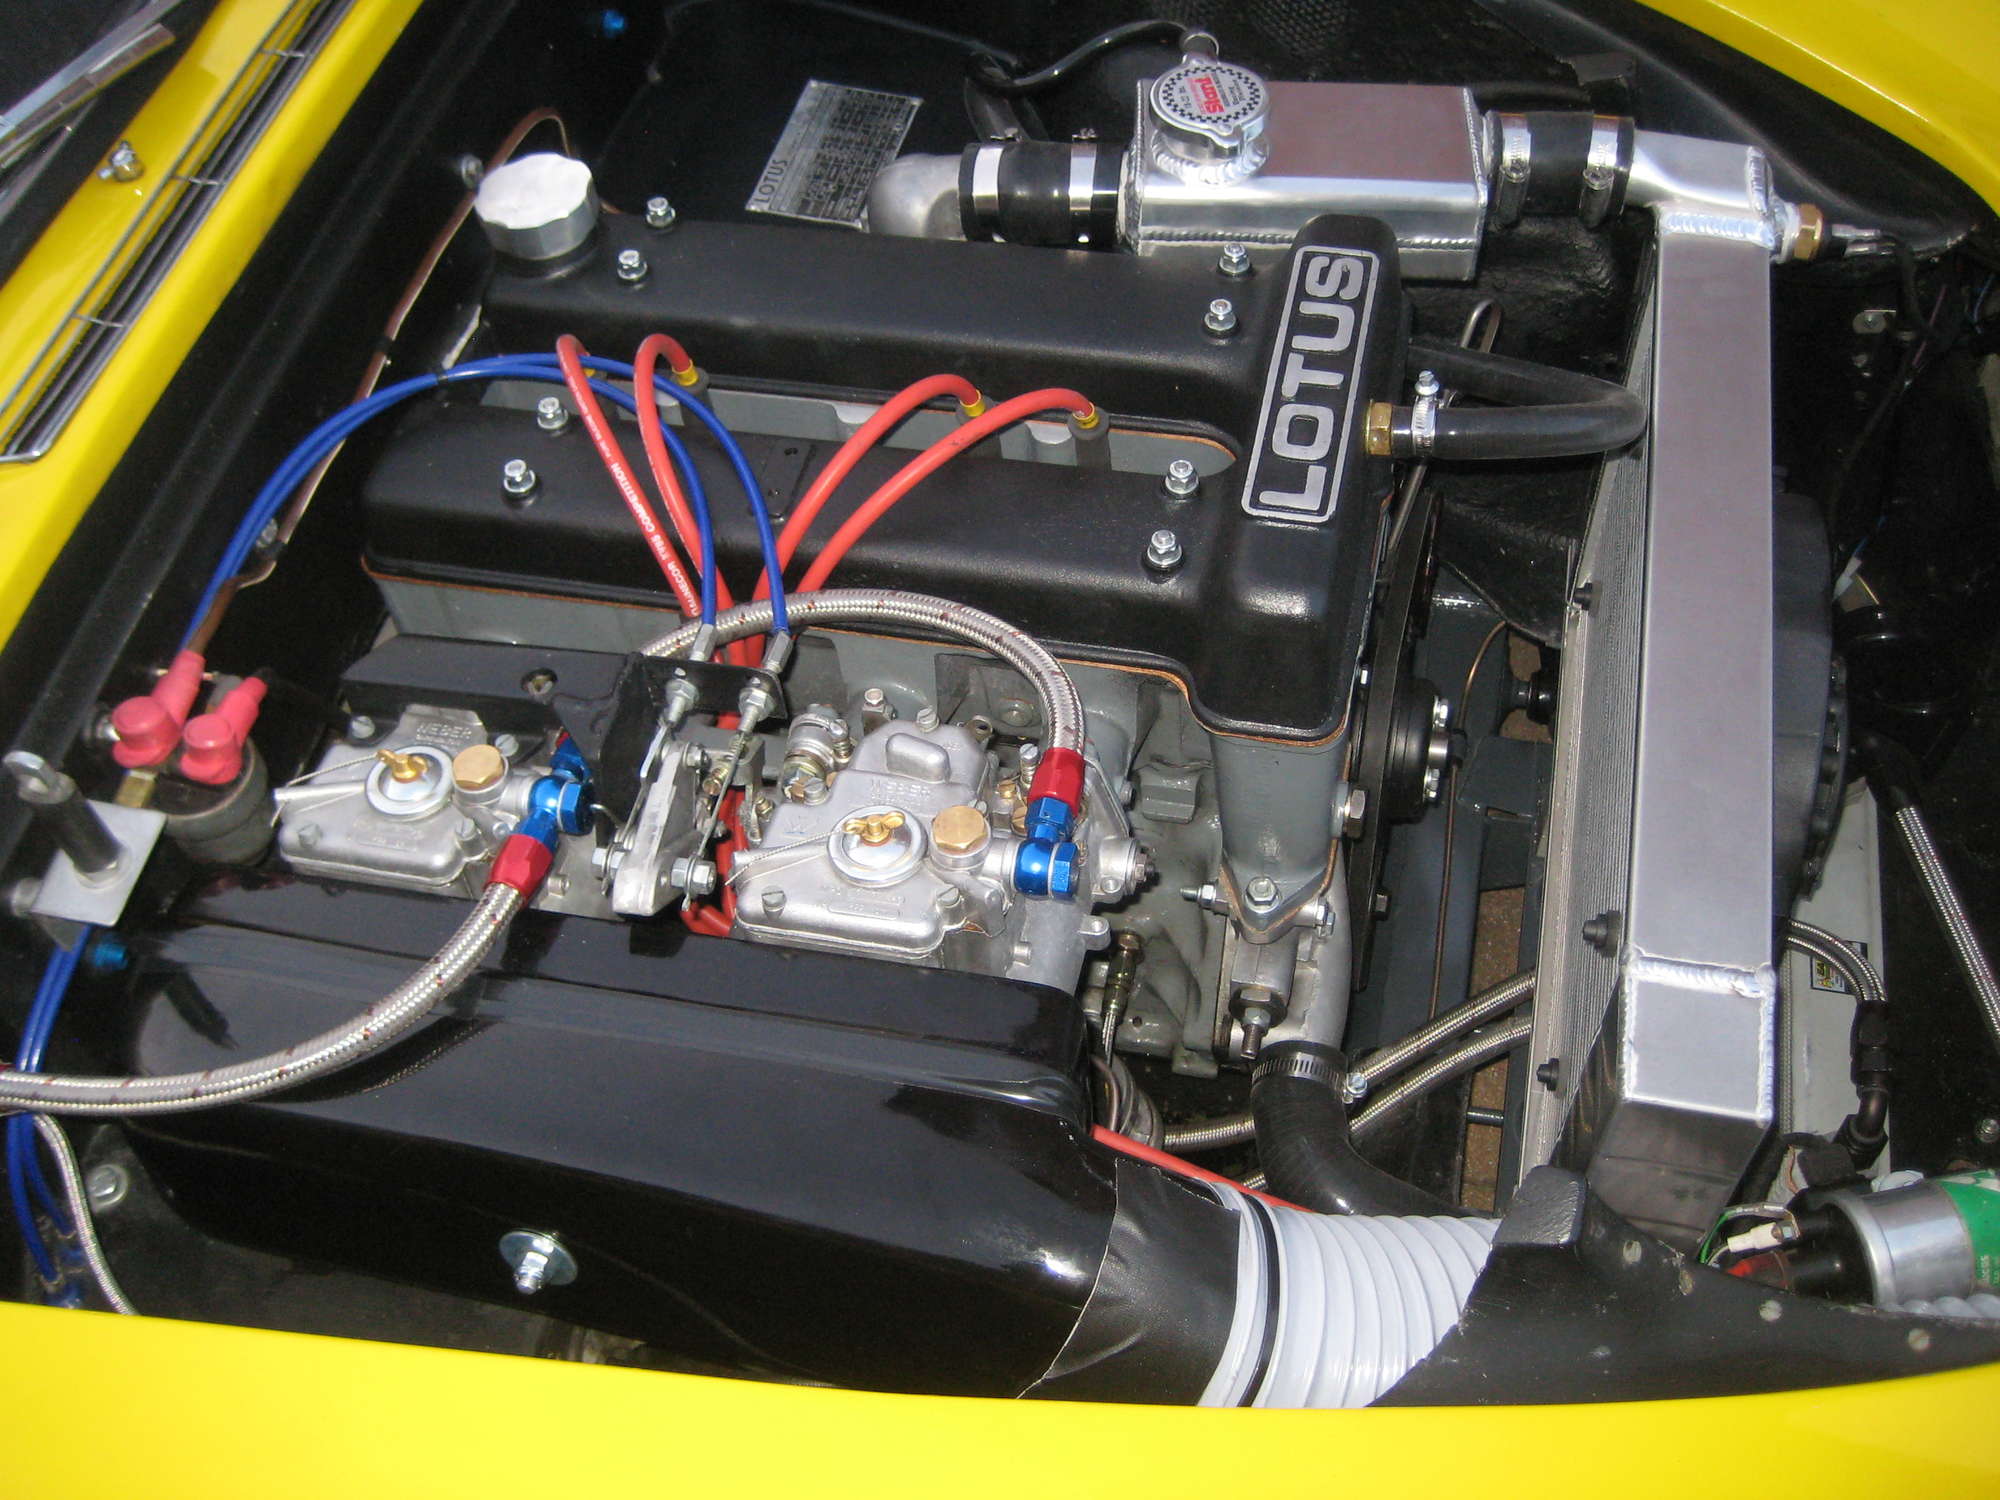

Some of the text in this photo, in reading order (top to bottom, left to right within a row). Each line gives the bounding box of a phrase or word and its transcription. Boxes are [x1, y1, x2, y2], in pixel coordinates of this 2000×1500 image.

[754, 159, 788, 203] LOTUS
[1259, 255, 1364, 511] LOTUS
[610, 462, 655, 533] COMPETITION
